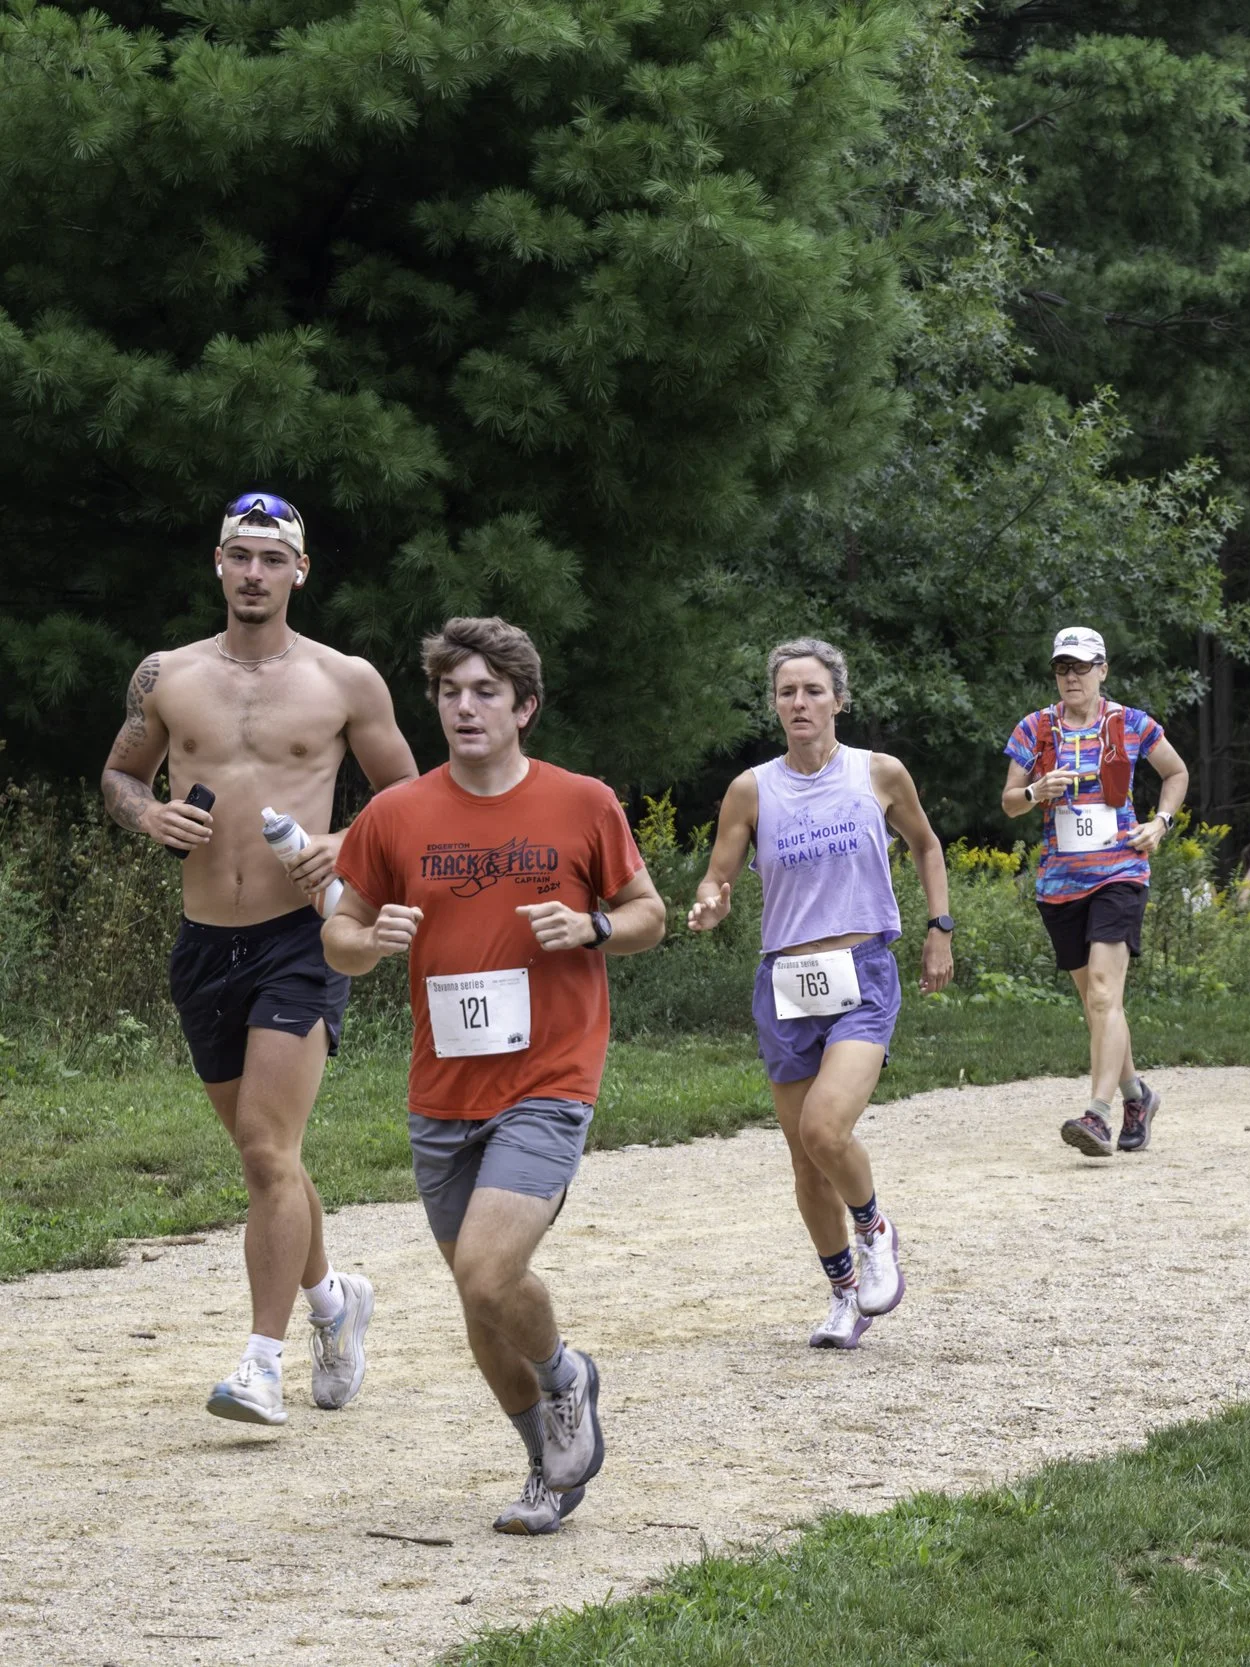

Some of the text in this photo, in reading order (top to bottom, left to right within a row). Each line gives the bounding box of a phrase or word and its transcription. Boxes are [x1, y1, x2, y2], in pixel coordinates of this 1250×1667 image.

[778, 822, 856, 850] BLUE MOUND
[1076, 818, 1093, 837] 58
[427, 842, 470, 851] EDGERTON
[780, 838, 857, 867] TRAIL RUN
[420, 847, 559, 877] TRACK & FIELD
[514, 876, 551, 884] CAPTAIN
[536, 882, 561, 894] 2024
[433, 982, 459, 992] Savanna
[460, 979, 484, 990] series
[796, 971, 829, 997] 763
[459, 995, 489, 1029] 121
